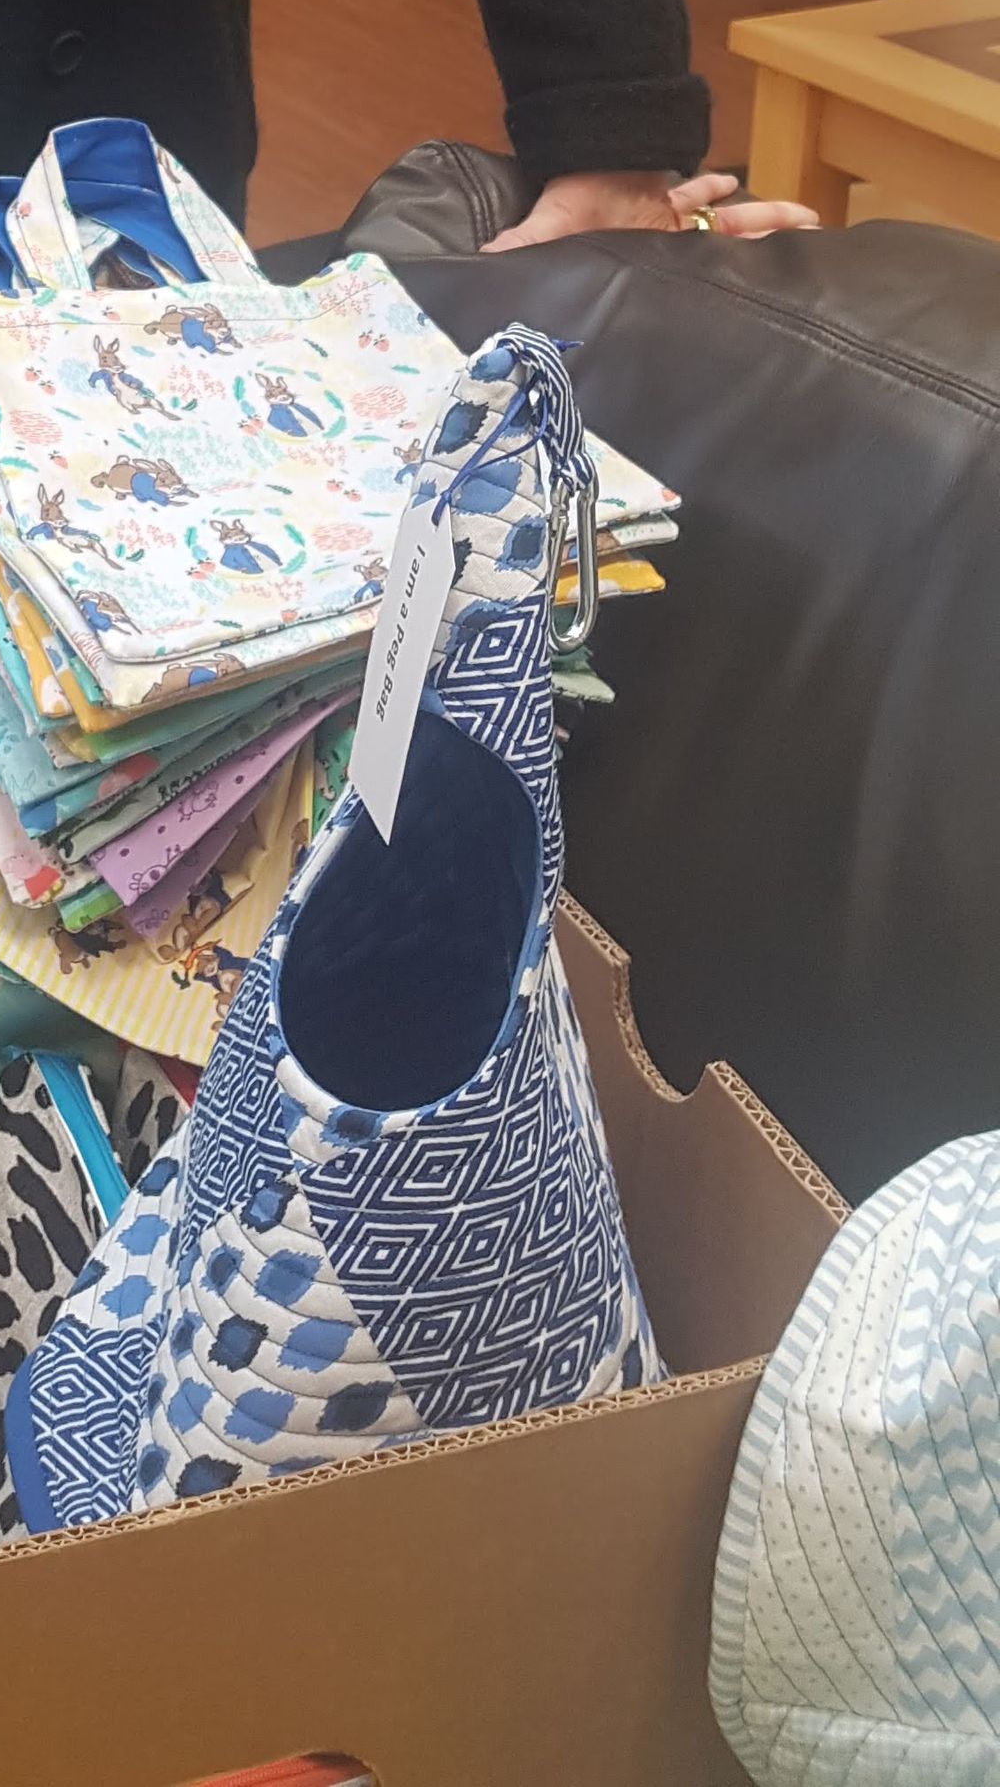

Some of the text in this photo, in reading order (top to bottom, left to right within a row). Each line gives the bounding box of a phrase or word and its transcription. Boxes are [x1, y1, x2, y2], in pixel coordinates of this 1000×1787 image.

[375, 544, 427, 724] I am a Peg Bag
